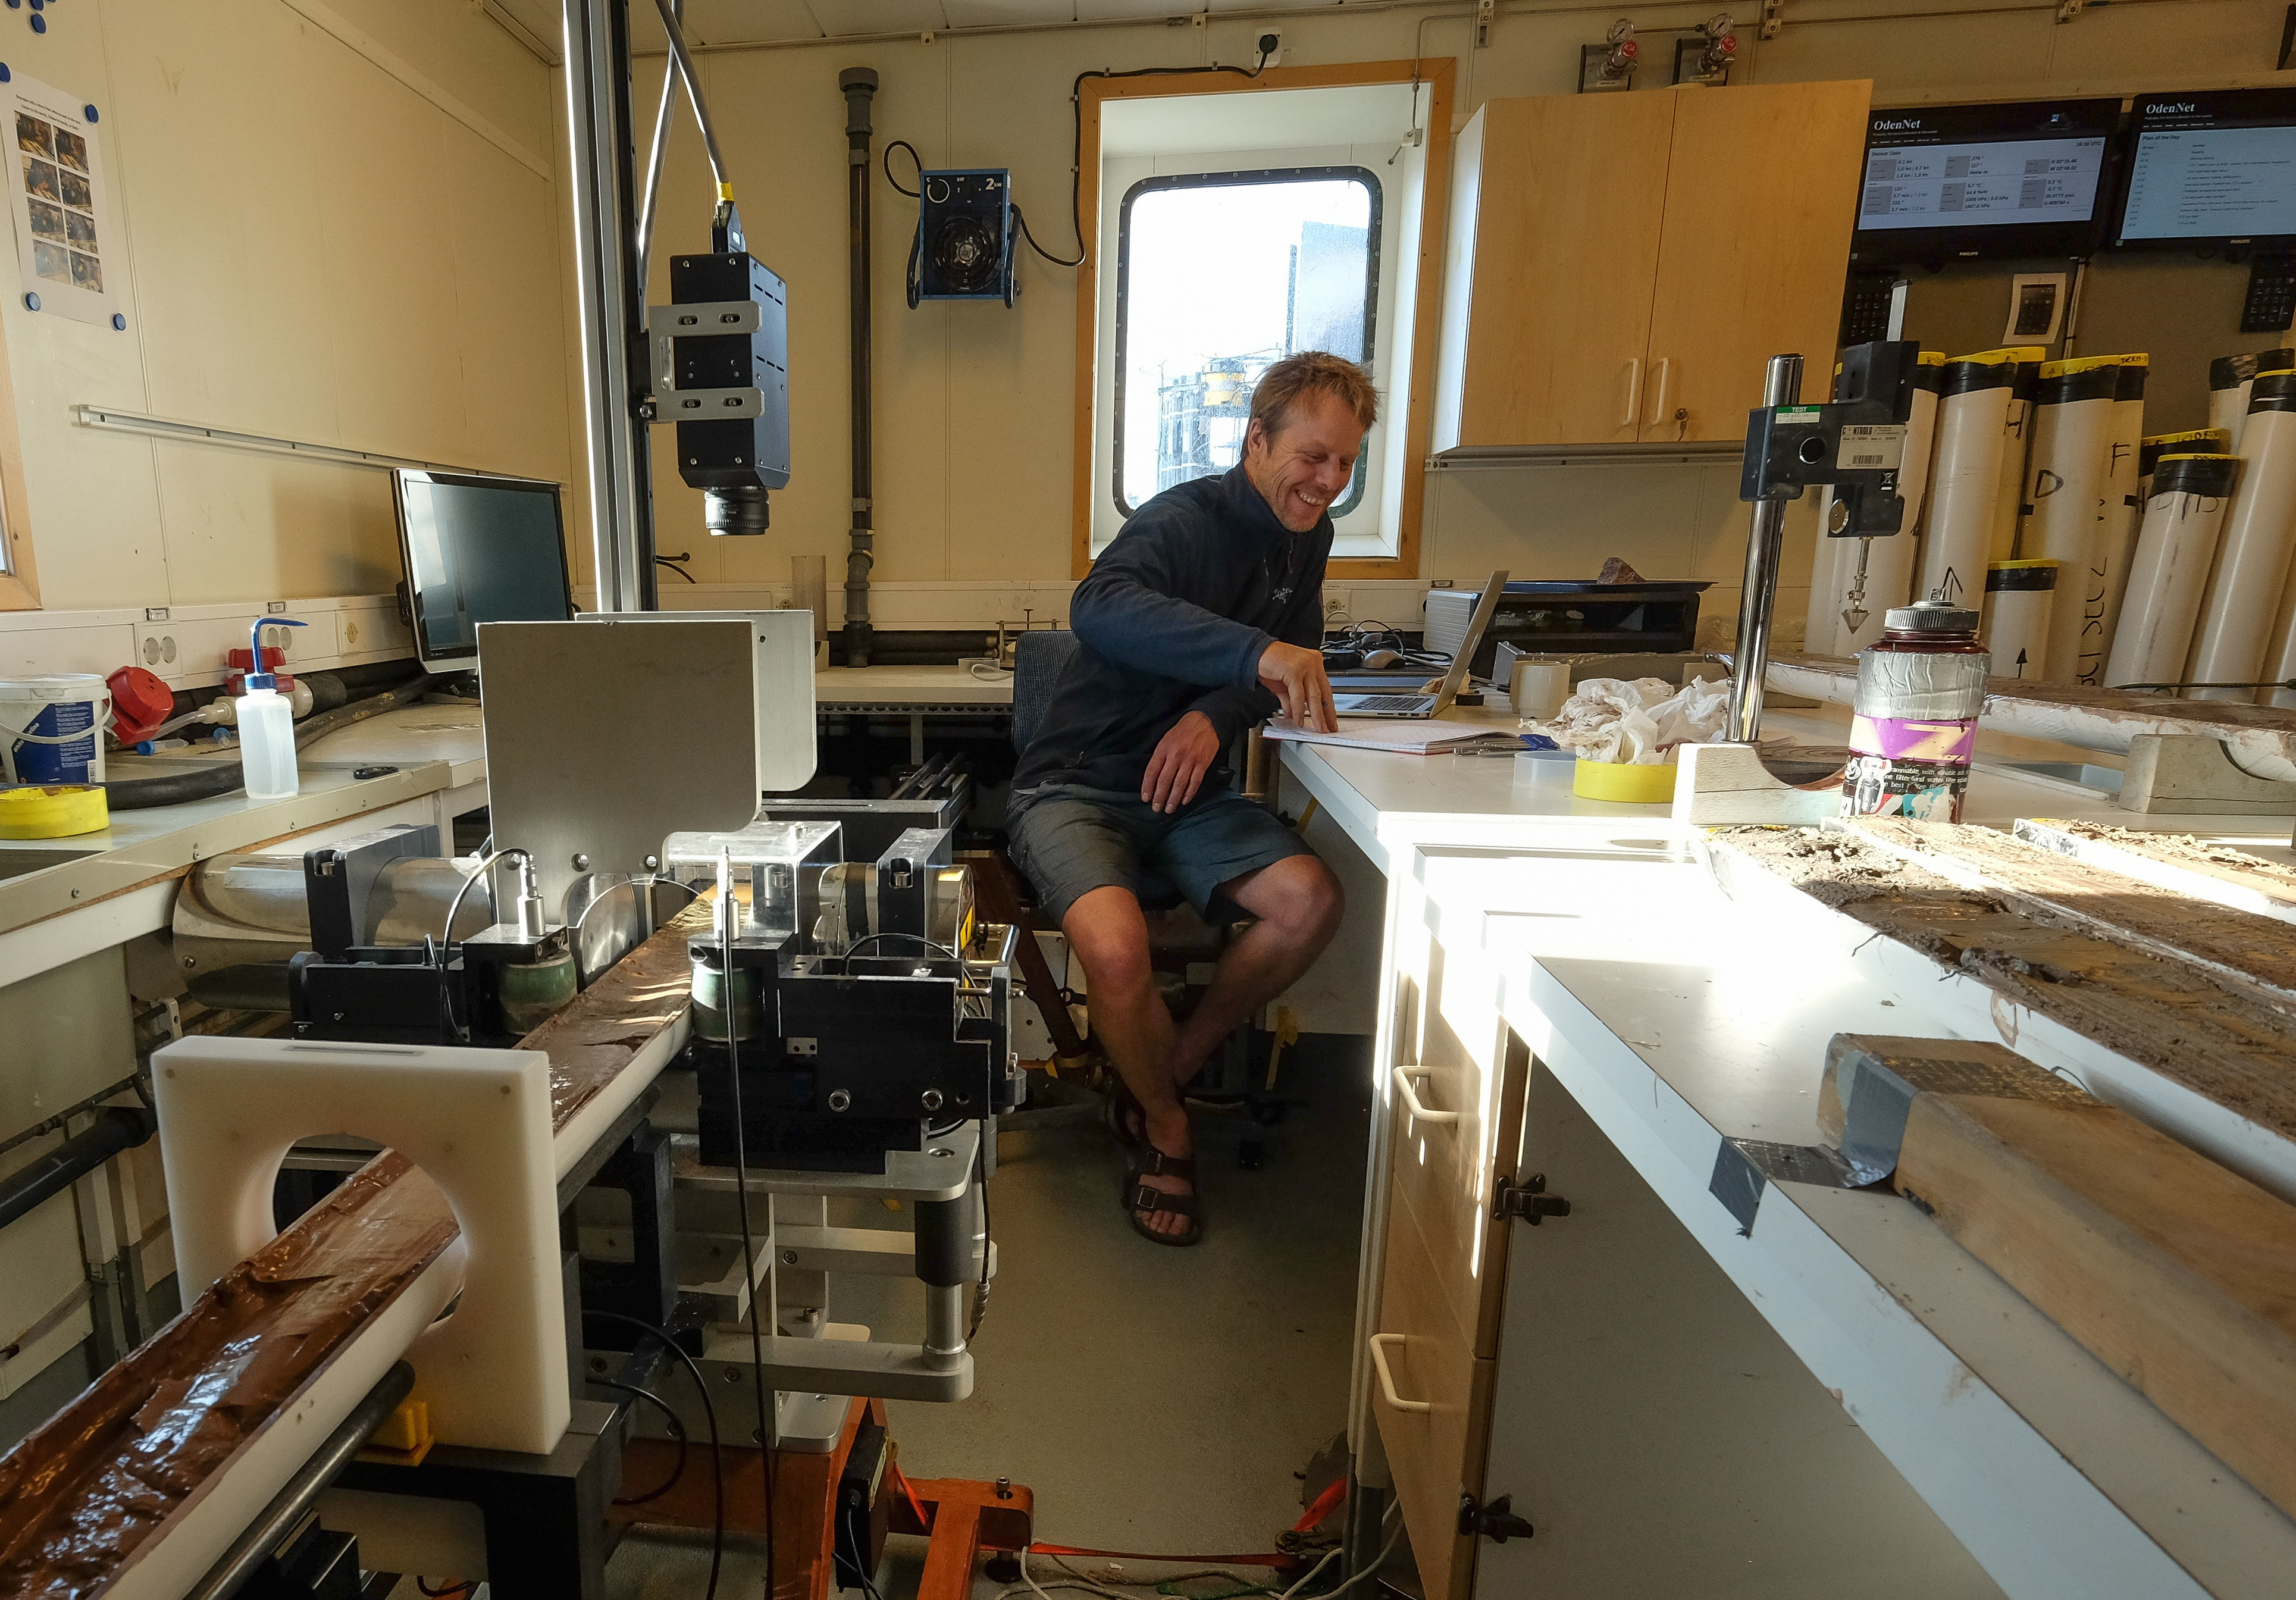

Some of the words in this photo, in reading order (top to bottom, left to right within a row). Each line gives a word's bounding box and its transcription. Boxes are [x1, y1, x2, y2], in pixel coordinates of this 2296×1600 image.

[2145, 103, 2195, 114] OdenNet
[1874, 120, 1921, 130] OdenNet
[1843, 427, 1872, 435] CNTROLS
[2110, 442, 2131, 478] F
[2035, 469, 2064, 499] D
[13, 740, 24, 753] White
